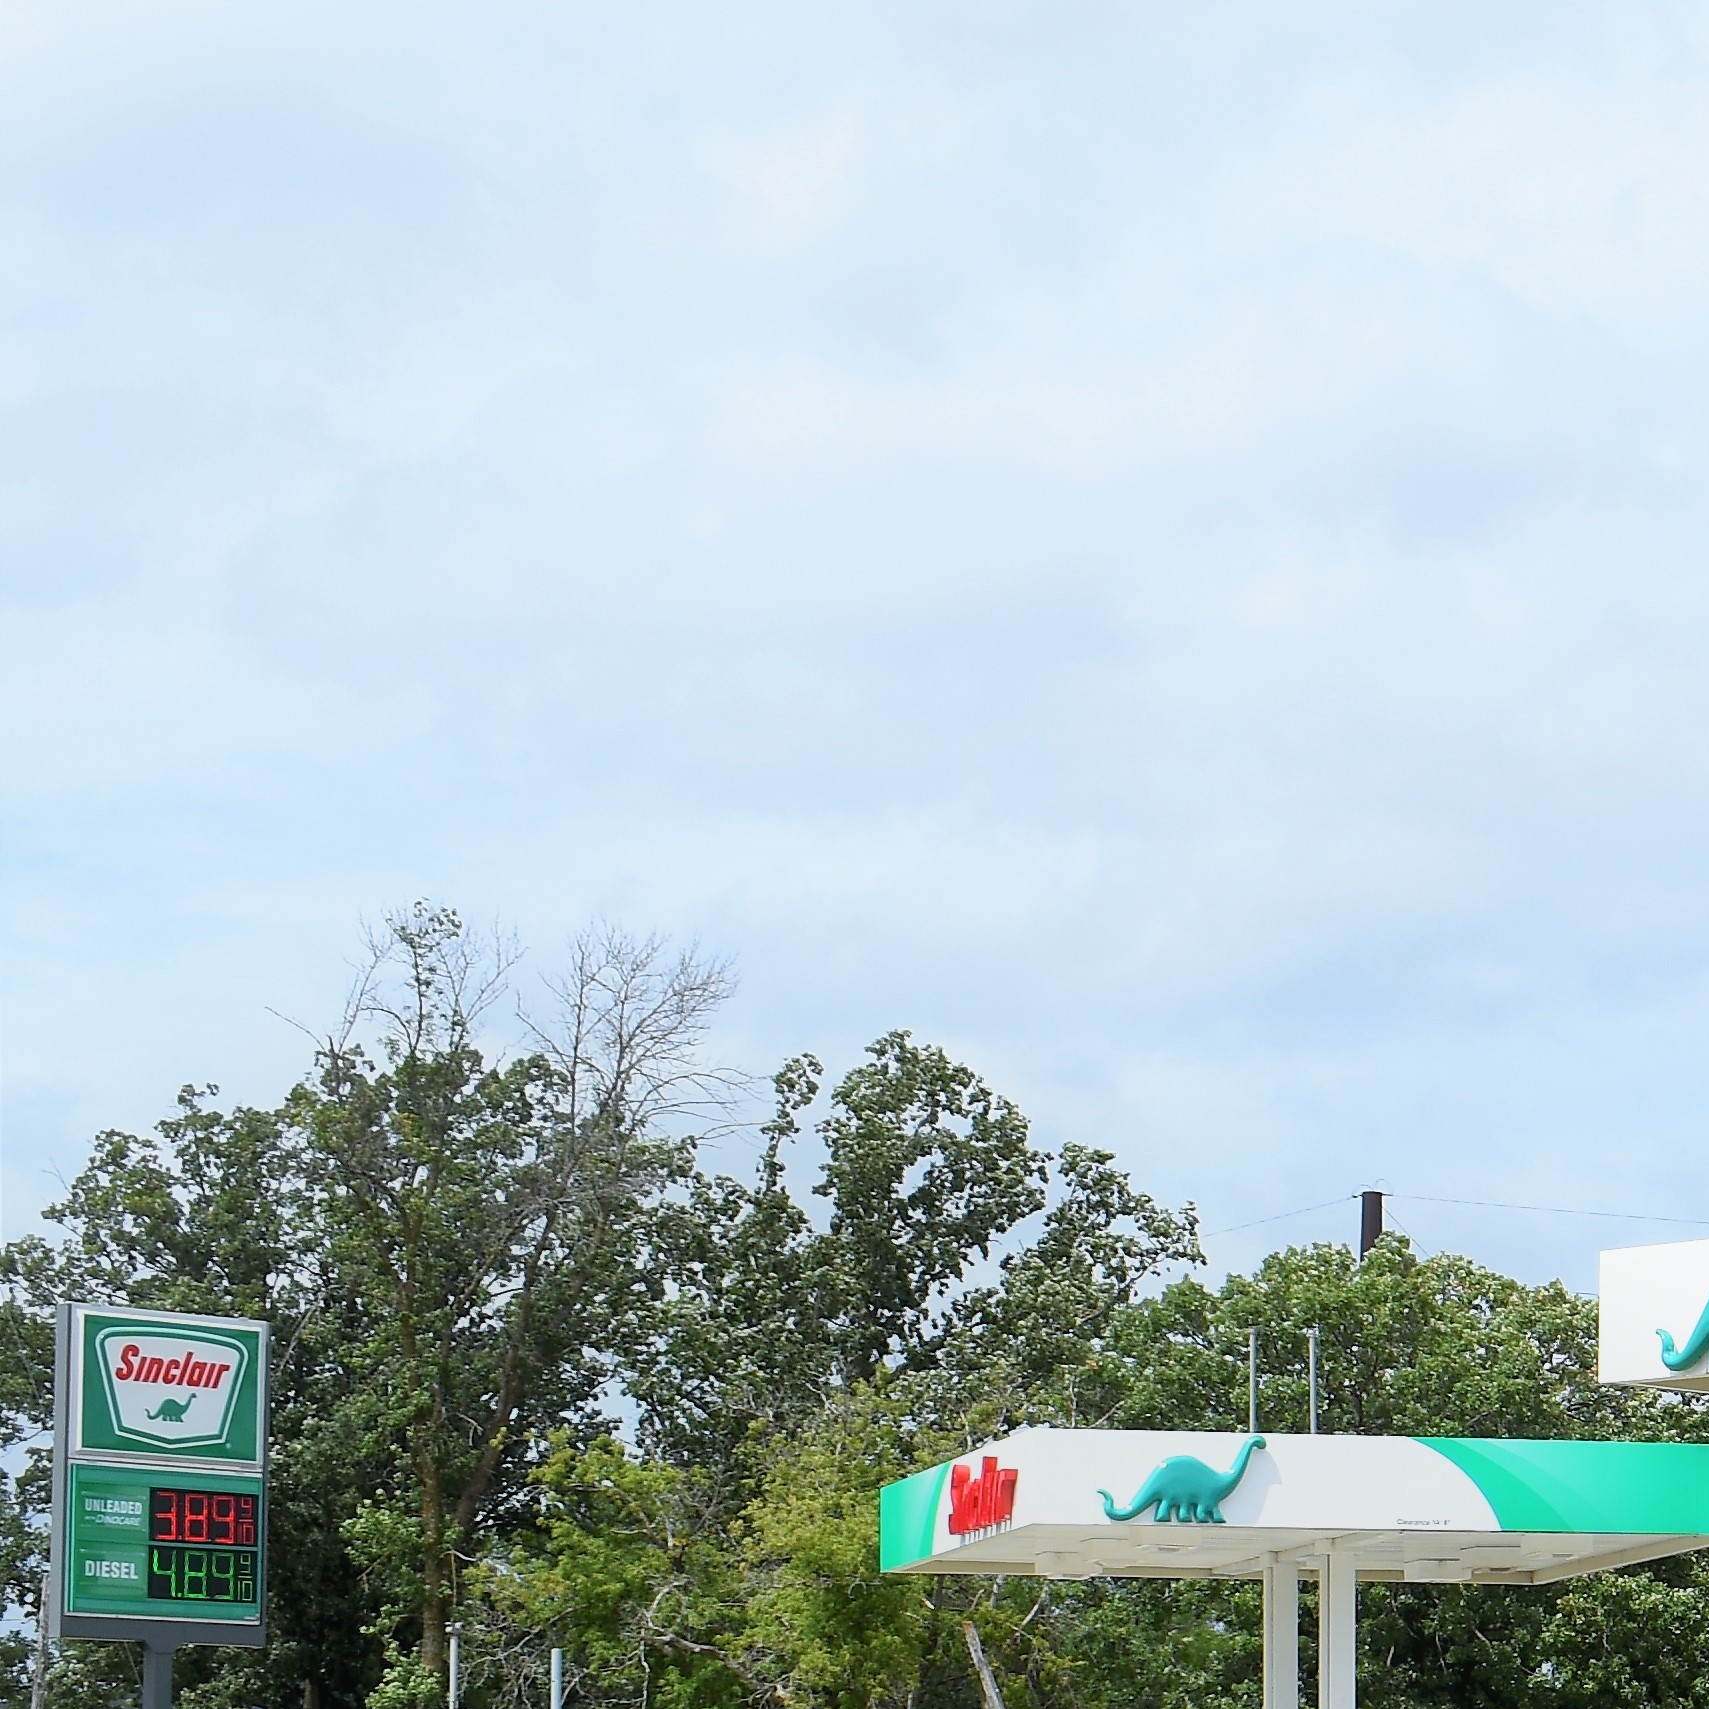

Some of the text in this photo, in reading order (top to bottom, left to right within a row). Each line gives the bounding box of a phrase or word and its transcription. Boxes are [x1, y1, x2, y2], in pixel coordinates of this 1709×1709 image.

[115, 1344, 231, 1389] Sinclair
[84, 1498, 143, 1515] UNLEADED
[155, 1491, 236, 1544] 3.89
[84, 1559, 140, 1580] DIESEL
[152, 1549, 235, 1600] 4.89
